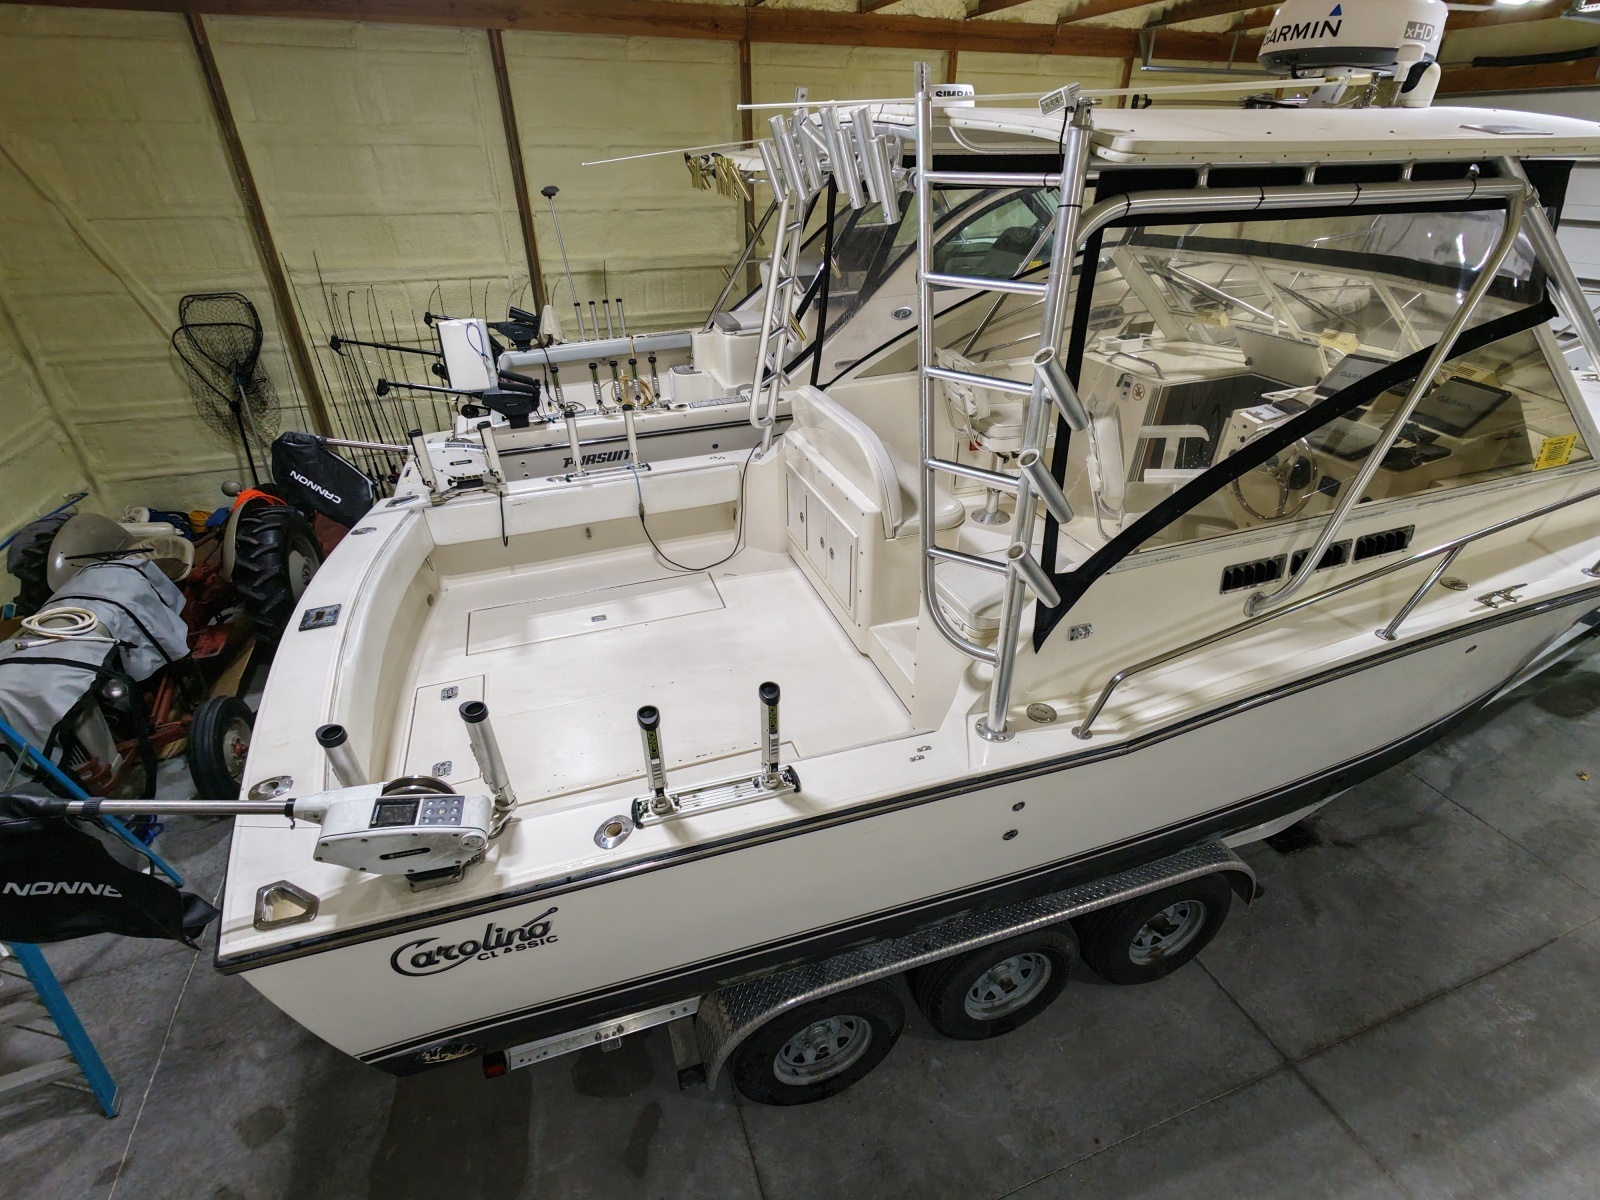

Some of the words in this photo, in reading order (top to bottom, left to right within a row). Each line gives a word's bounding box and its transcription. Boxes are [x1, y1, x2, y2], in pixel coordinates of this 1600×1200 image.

[1262, 20, 1342, 46] GARMIN
[1406, 24, 1433, 41] xHD
[290, 470, 341, 504] CANNON
[2, 881, 123, 897] ANNON
[390, 908, 557, 977] Carolina
[477, 935, 558, 961] CLASSIC
